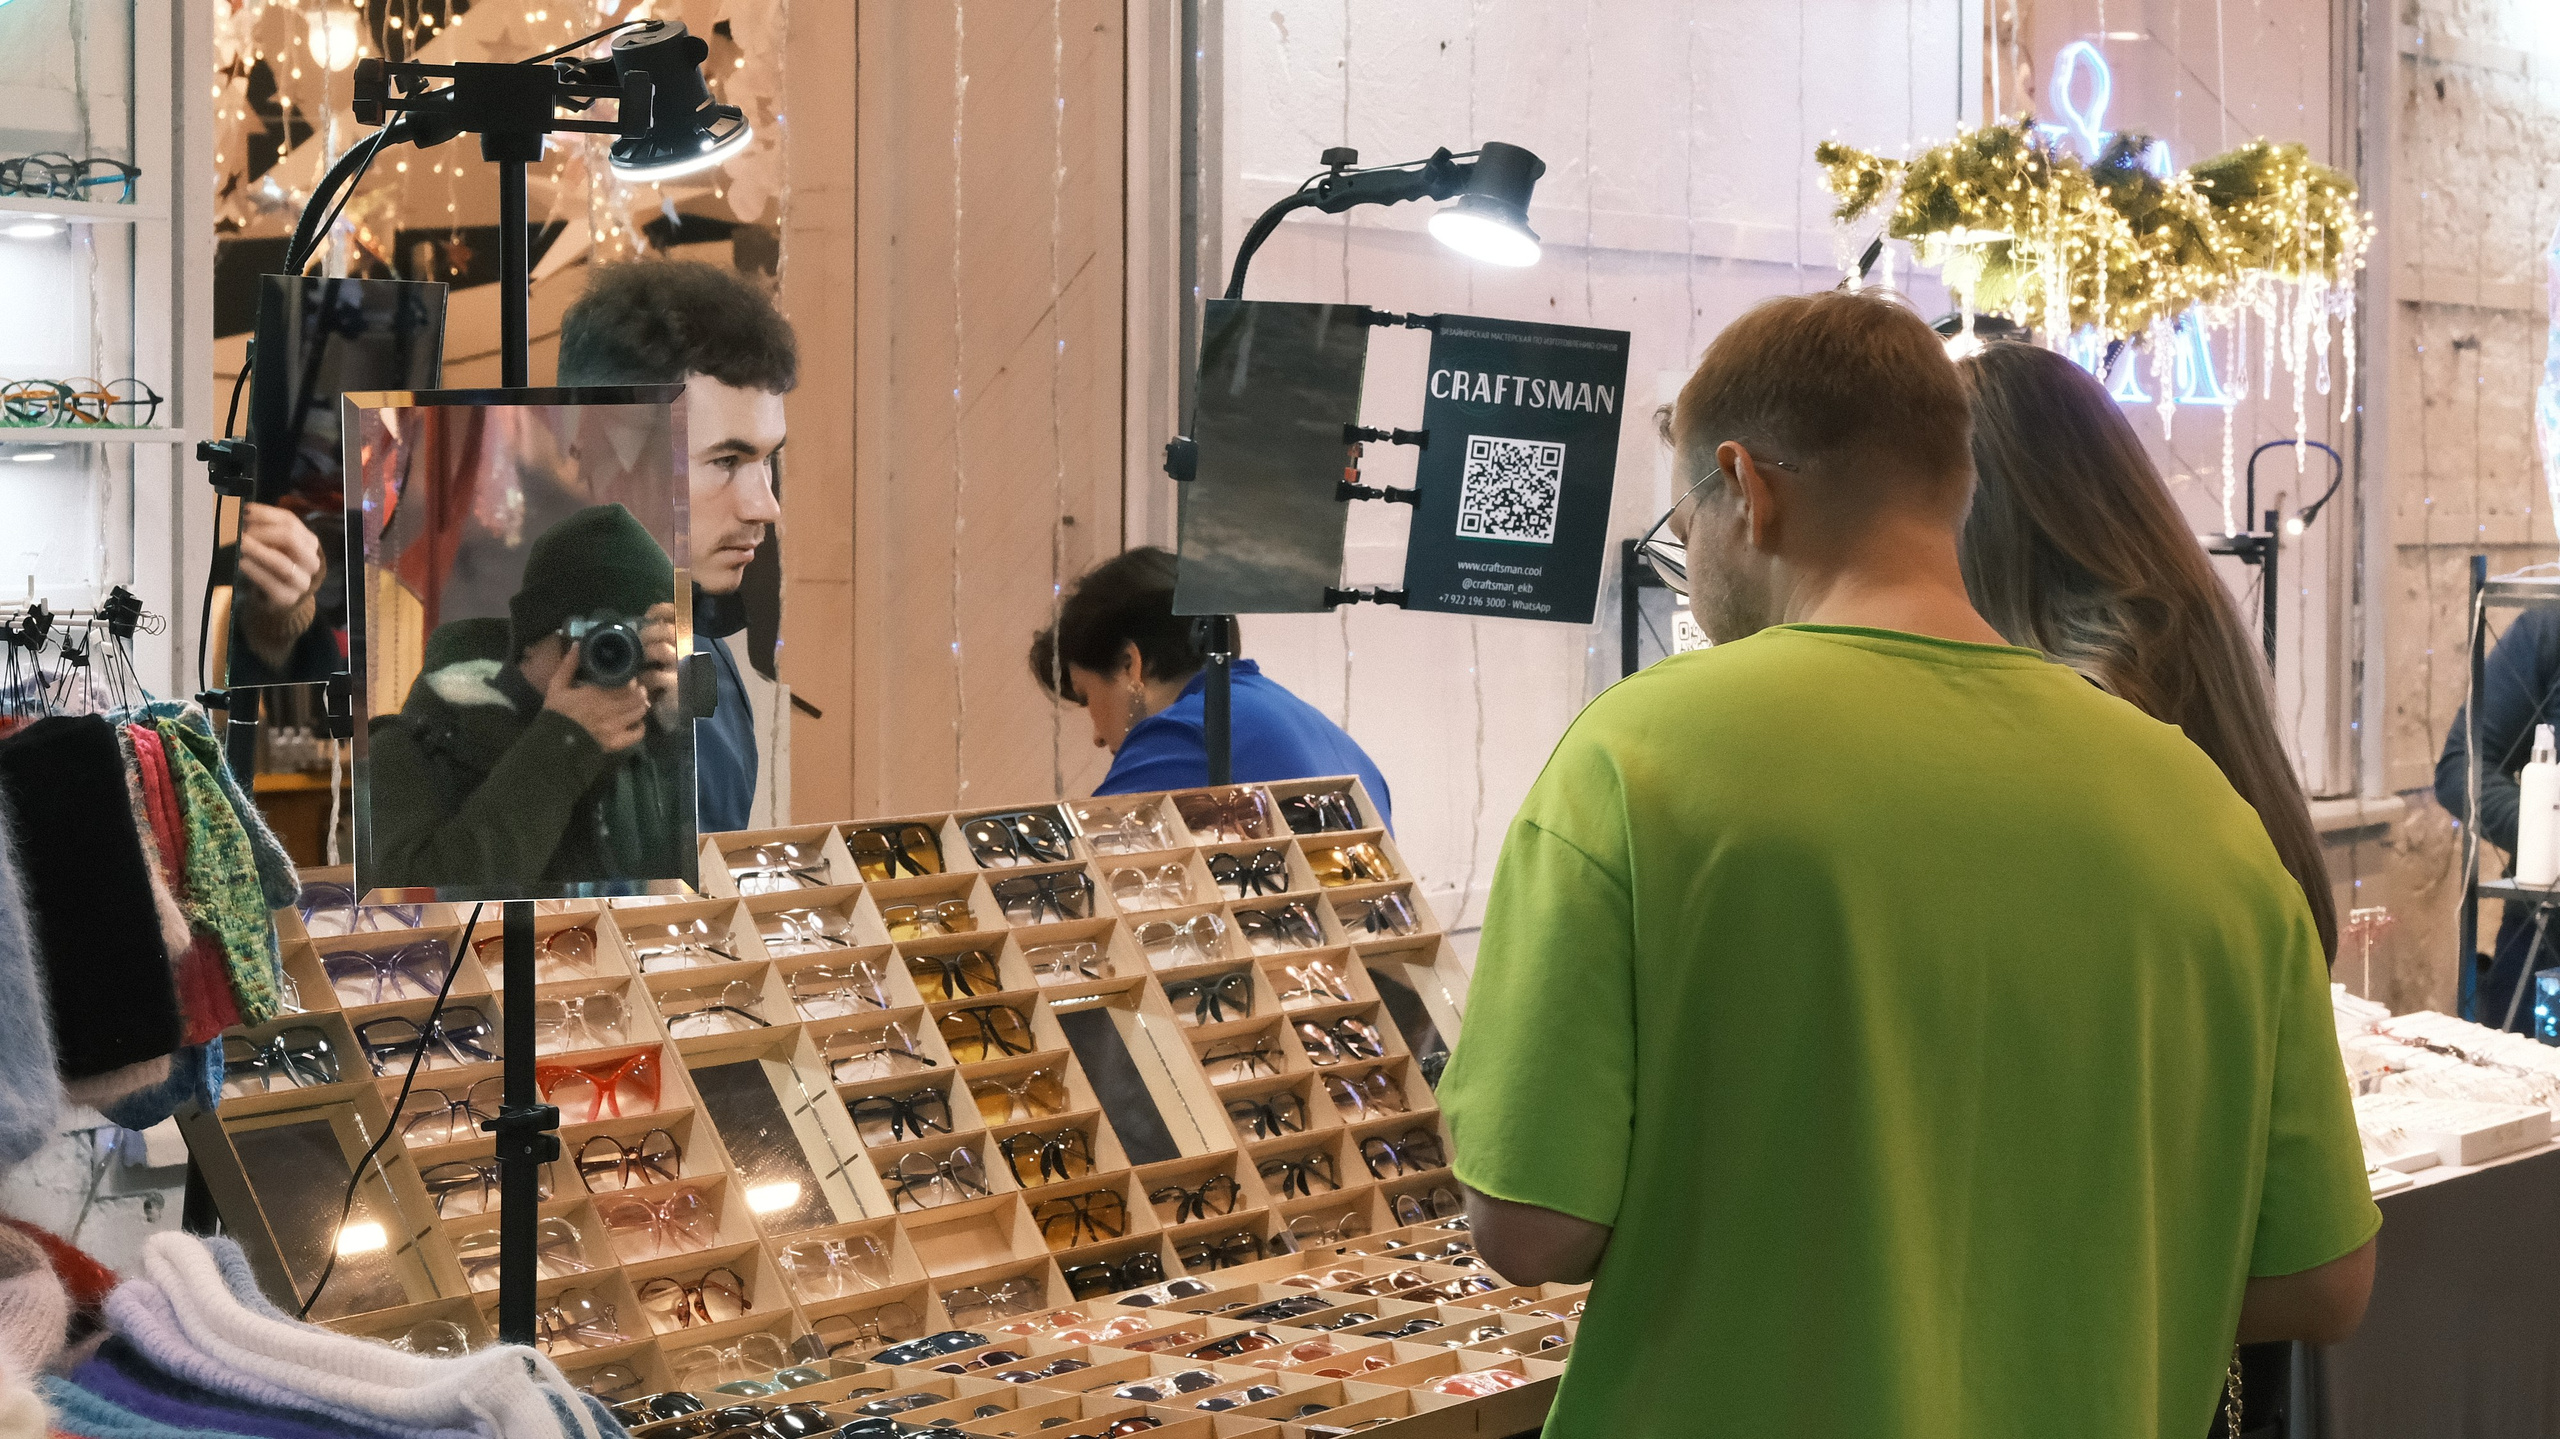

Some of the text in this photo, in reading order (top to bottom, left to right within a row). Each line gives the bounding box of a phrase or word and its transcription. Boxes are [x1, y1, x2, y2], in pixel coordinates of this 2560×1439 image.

[1430, 369, 1615, 414] CRAFTSMAN
[1457, 561, 1542, 576] www.craftsman.cool
[1461, 577, 1534, 595] @craftsman_ekb
[1438, 593, 1449, 603] +7
[1450, 594, 1466, 605] 922
[1468, 596, 1483, 606] 196
[1486, 597, 1507, 609] 3000
[1512, 600, 1551, 614] WhatsApp
